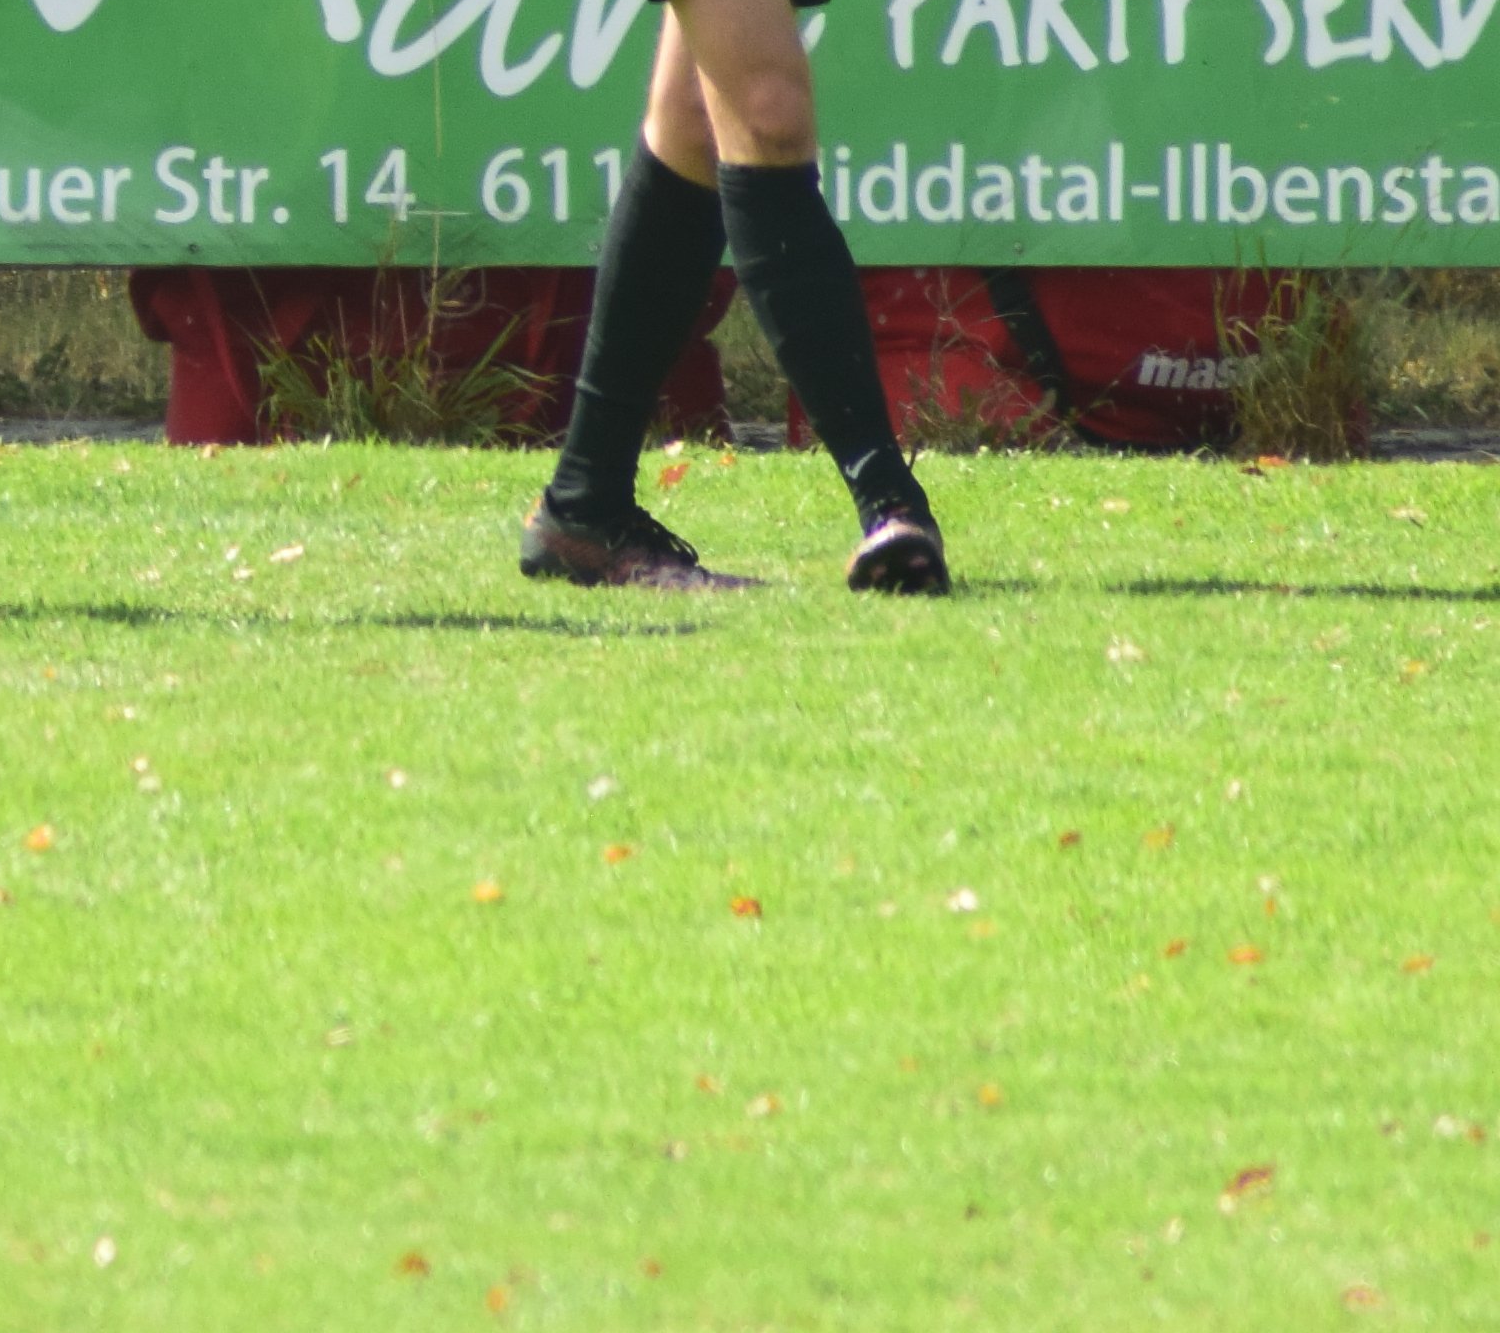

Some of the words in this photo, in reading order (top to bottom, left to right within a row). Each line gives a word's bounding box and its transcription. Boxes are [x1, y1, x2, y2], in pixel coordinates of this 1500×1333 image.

[154, 145, 290, 225] Str.
[319, 148, 417, 223] 14
[481, 146, 622, 223] 611
[818, 142, 1500, 225] iddatal-Ilbensta
